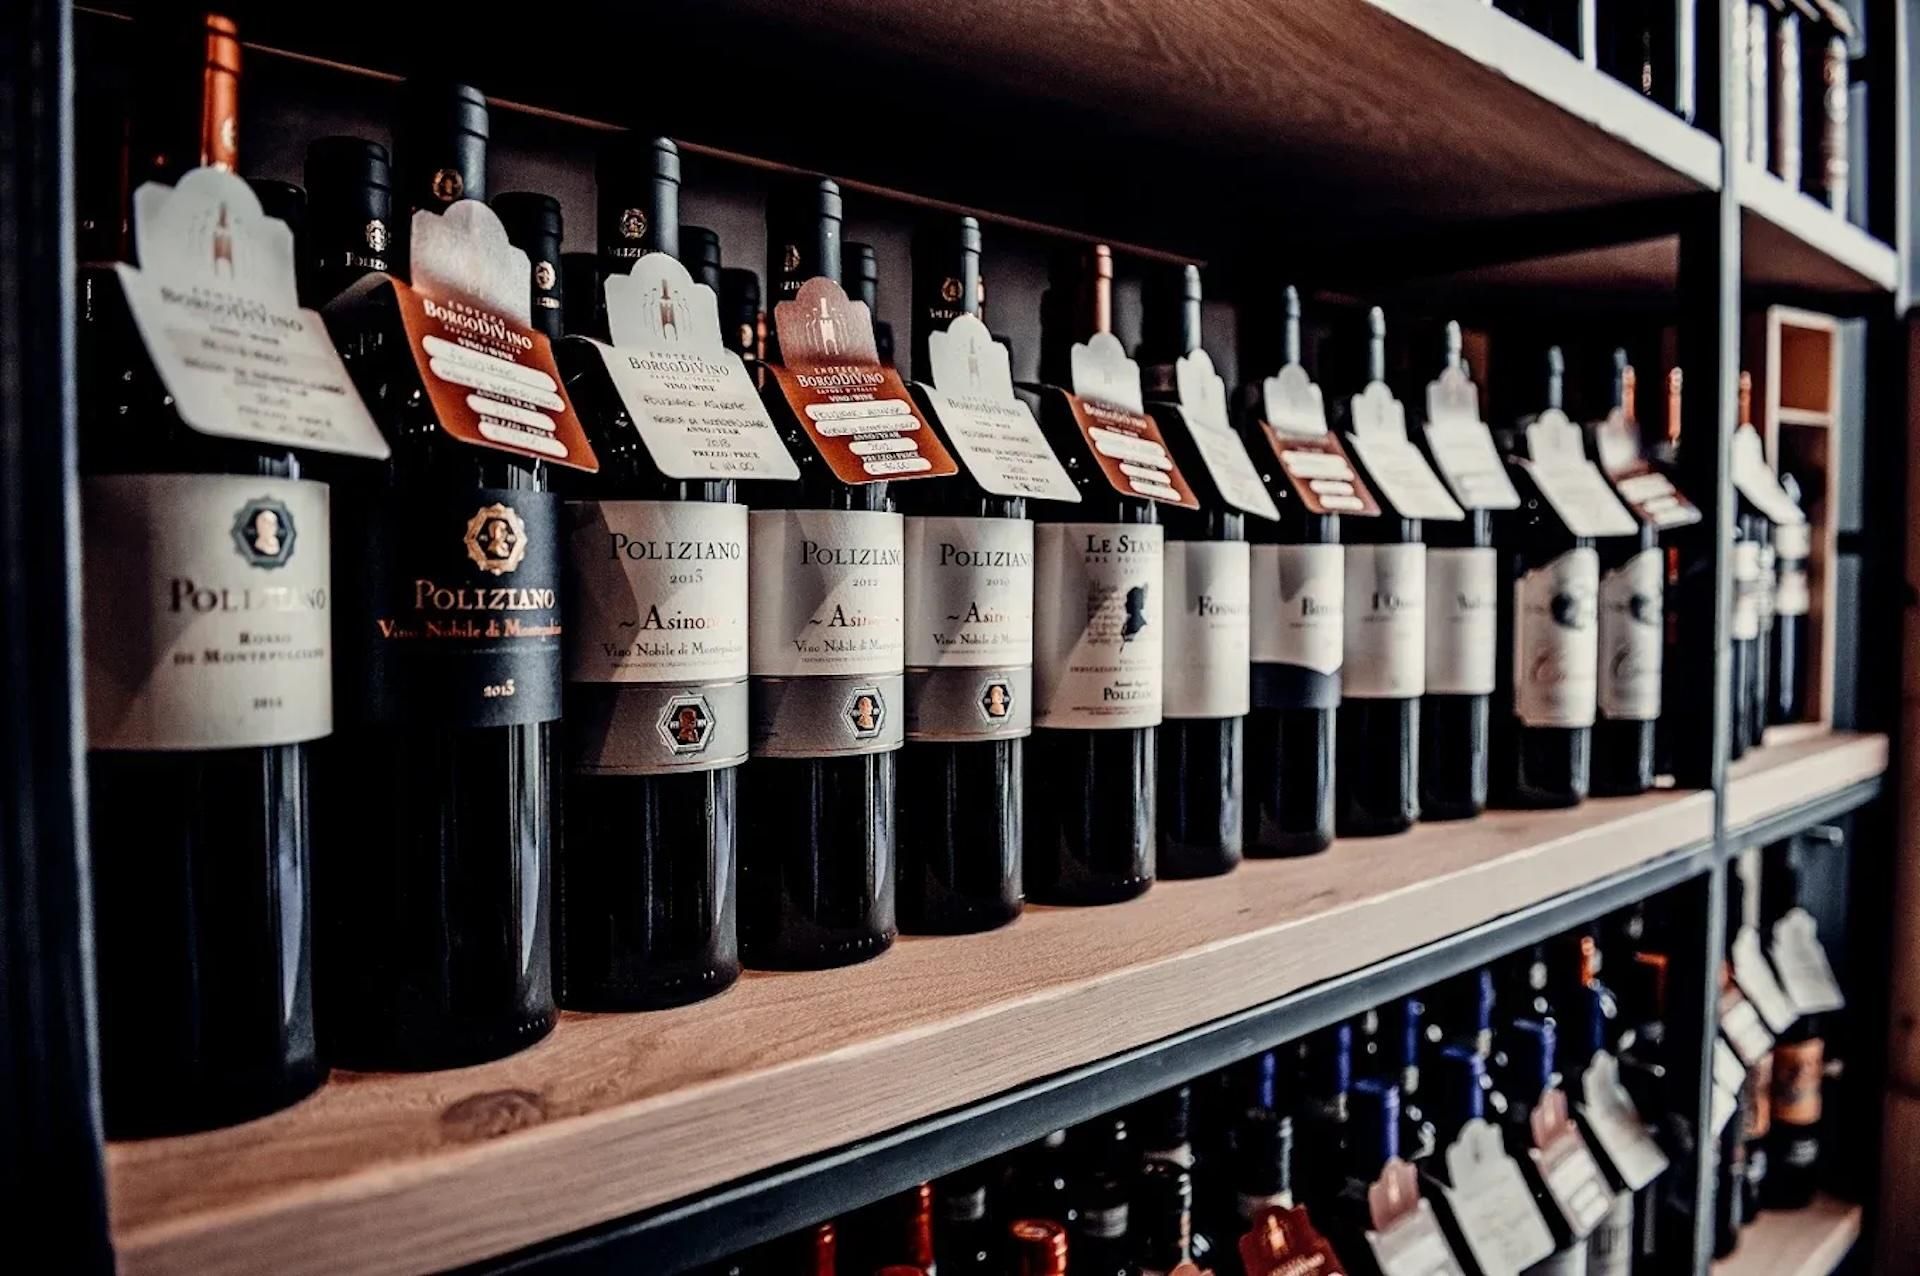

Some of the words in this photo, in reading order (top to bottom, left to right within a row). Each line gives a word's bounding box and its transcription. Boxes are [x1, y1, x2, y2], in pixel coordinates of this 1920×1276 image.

[423, 298, 533, 350] BORGODIVINO
[628, 356, 730, 376] BORGODIVINO
[795, 372, 885, 388] BORGODIVINO
[608, 532, 740, 560] POLIZIANO
[1086, 535, 1112, 553] LE
[939, 543, 1031, 567] POLIZIAN
[669, 568, 704, 584] 2015
[415, 578, 556, 610] POLIZIANO
[426, 619, 479, 638] Nobile
[483, 618, 498, 638] di
[601, 642, 632, 658] Vino
[636, 641, 675, 657] Nobile
[679, 641, 688, 655] di
[792, 639, 821, 652] Vino
[483, 679, 516, 698] 2015
